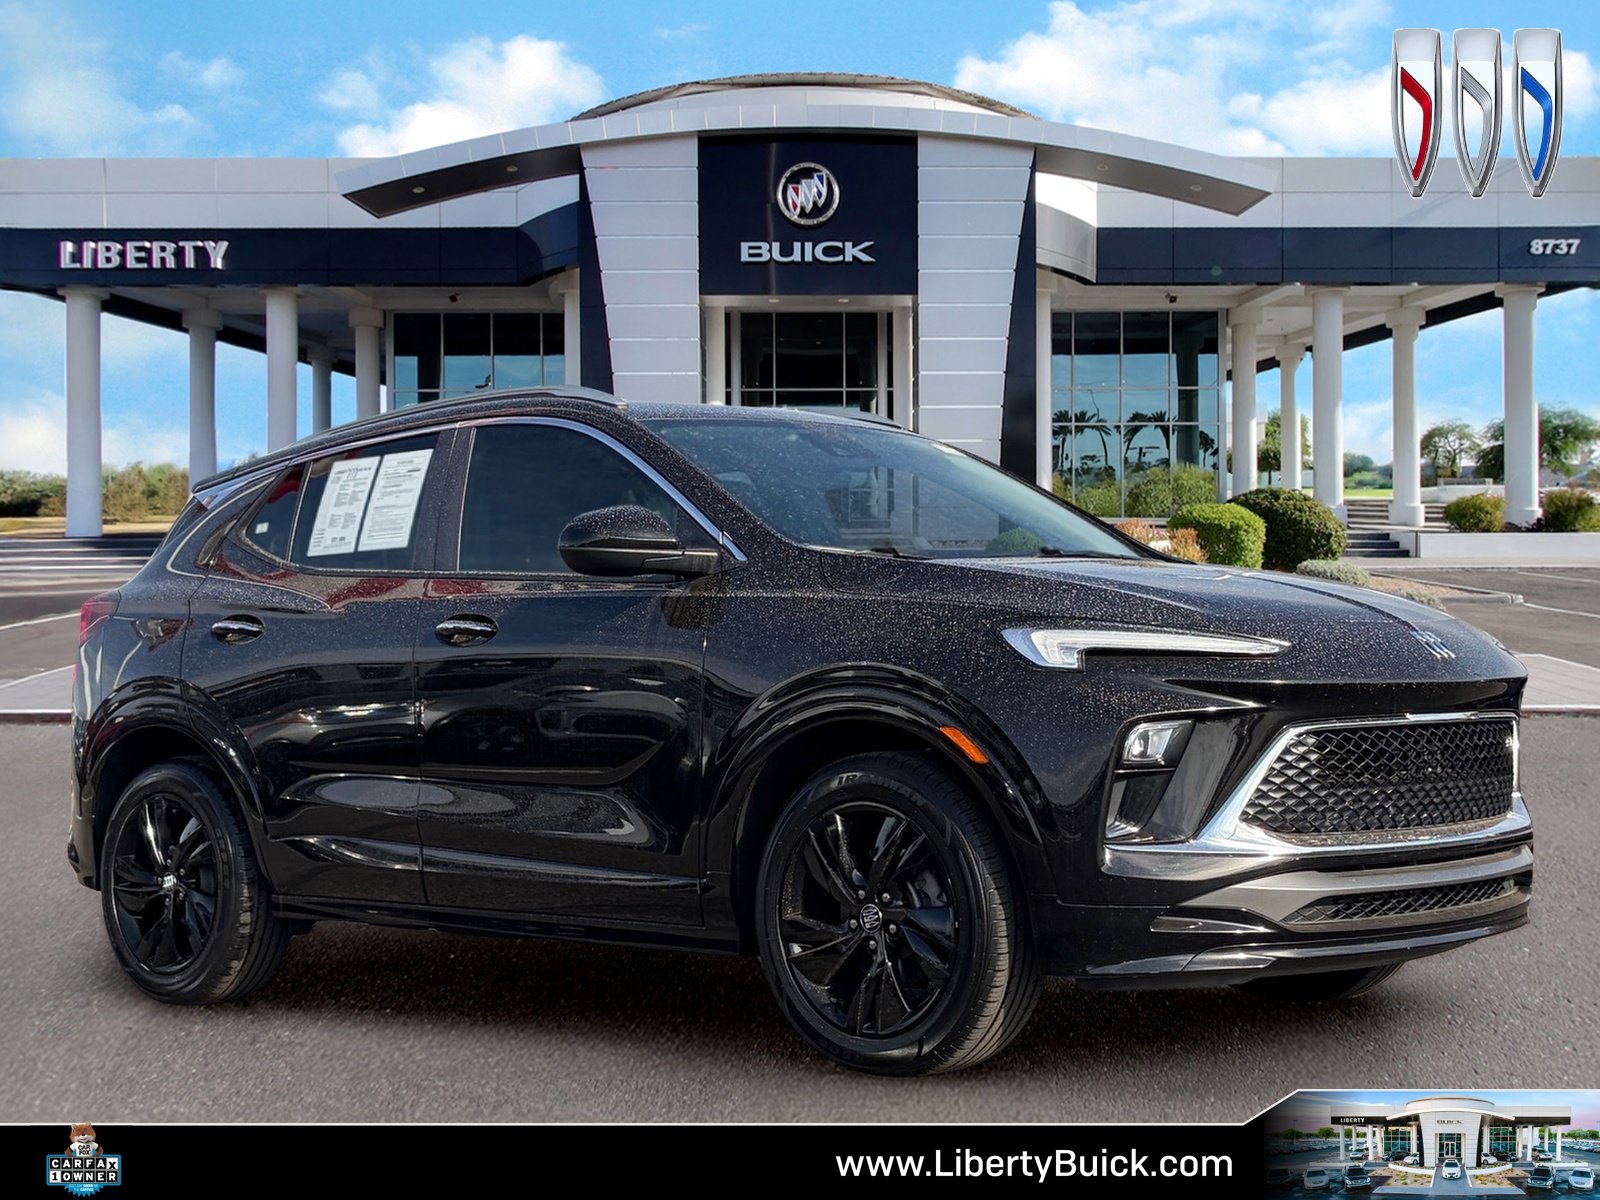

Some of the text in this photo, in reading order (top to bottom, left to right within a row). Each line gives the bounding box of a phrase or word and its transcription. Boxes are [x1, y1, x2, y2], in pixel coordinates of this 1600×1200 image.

[59, 240, 229, 270] LIBERTY
[740, 241, 876, 263] BUICK
[1530, 238, 1581, 255] 8737
